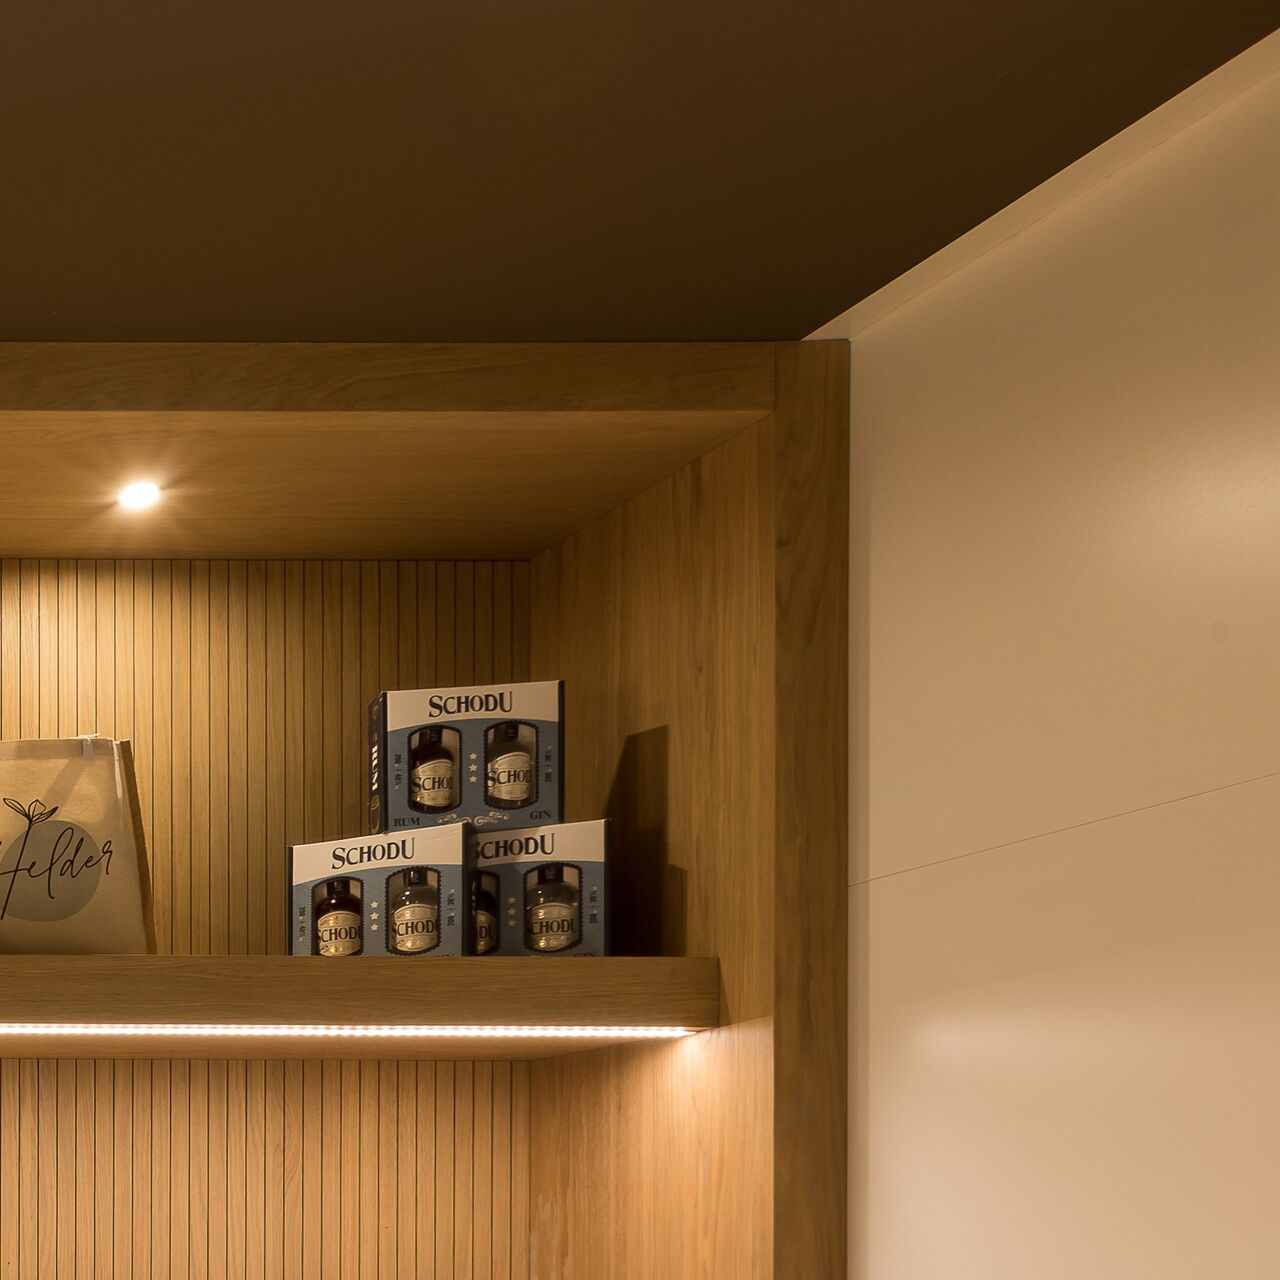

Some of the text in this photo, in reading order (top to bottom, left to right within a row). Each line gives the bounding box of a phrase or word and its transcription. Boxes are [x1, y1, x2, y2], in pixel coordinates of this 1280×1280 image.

[428, 691, 513, 718] SCHODU
[394, 817, 420, 827] RUM
[529, 811, 551, 820] GIN
[331, 837, 415, 870] SCHODU
